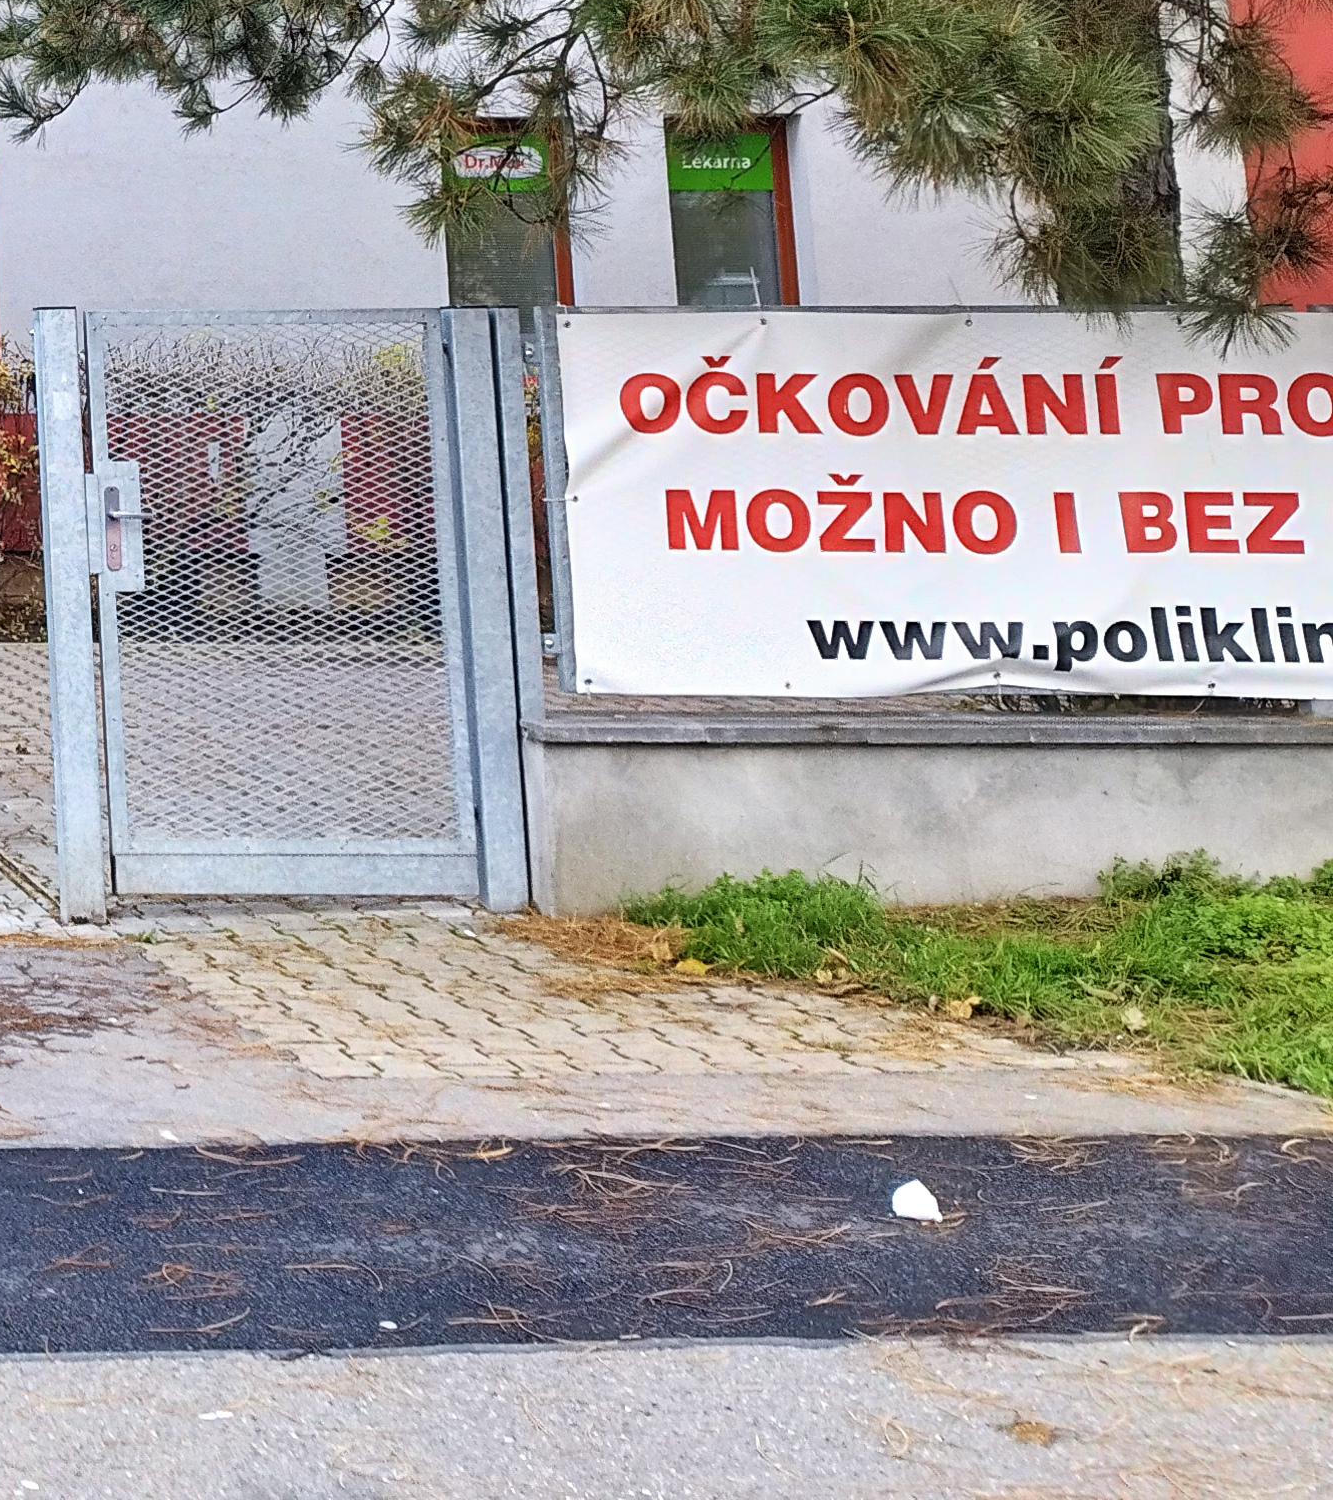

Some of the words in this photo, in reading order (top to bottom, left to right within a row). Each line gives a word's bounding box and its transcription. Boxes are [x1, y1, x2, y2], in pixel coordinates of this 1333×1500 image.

[620, 355, 1123, 435] OČKOVÁNÍ
[1155, 372, 1333, 437] PRO
[665, 473, 1018, 554] MOŽNO
[1053, 492, 1082, 554] I
[1118, 491, 1305, 554] BEZ
